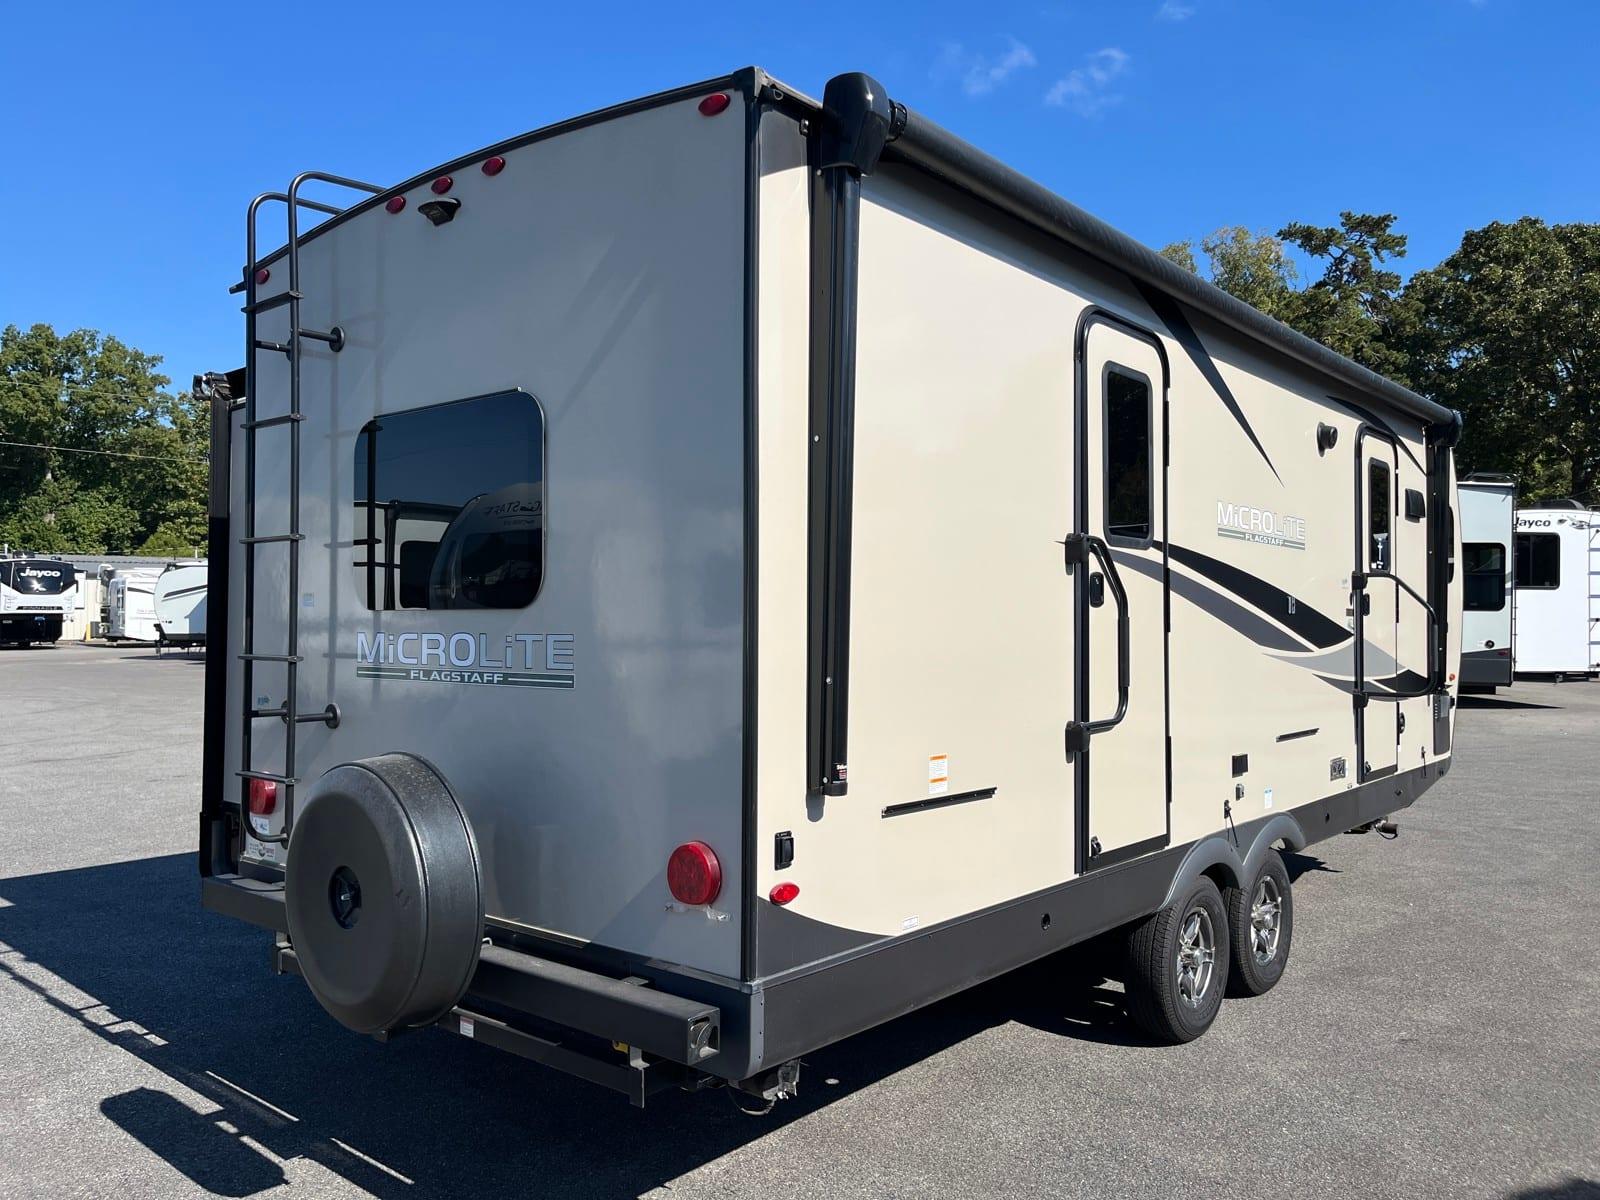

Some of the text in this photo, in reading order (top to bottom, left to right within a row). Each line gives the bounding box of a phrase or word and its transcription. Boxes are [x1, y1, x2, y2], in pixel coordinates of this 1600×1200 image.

[1244, 533, 1284, 546] FLAGSTAFF
[19, 566, 61, 578] Jayco
[410, 669, 504, 684] FLAGSTAFF
